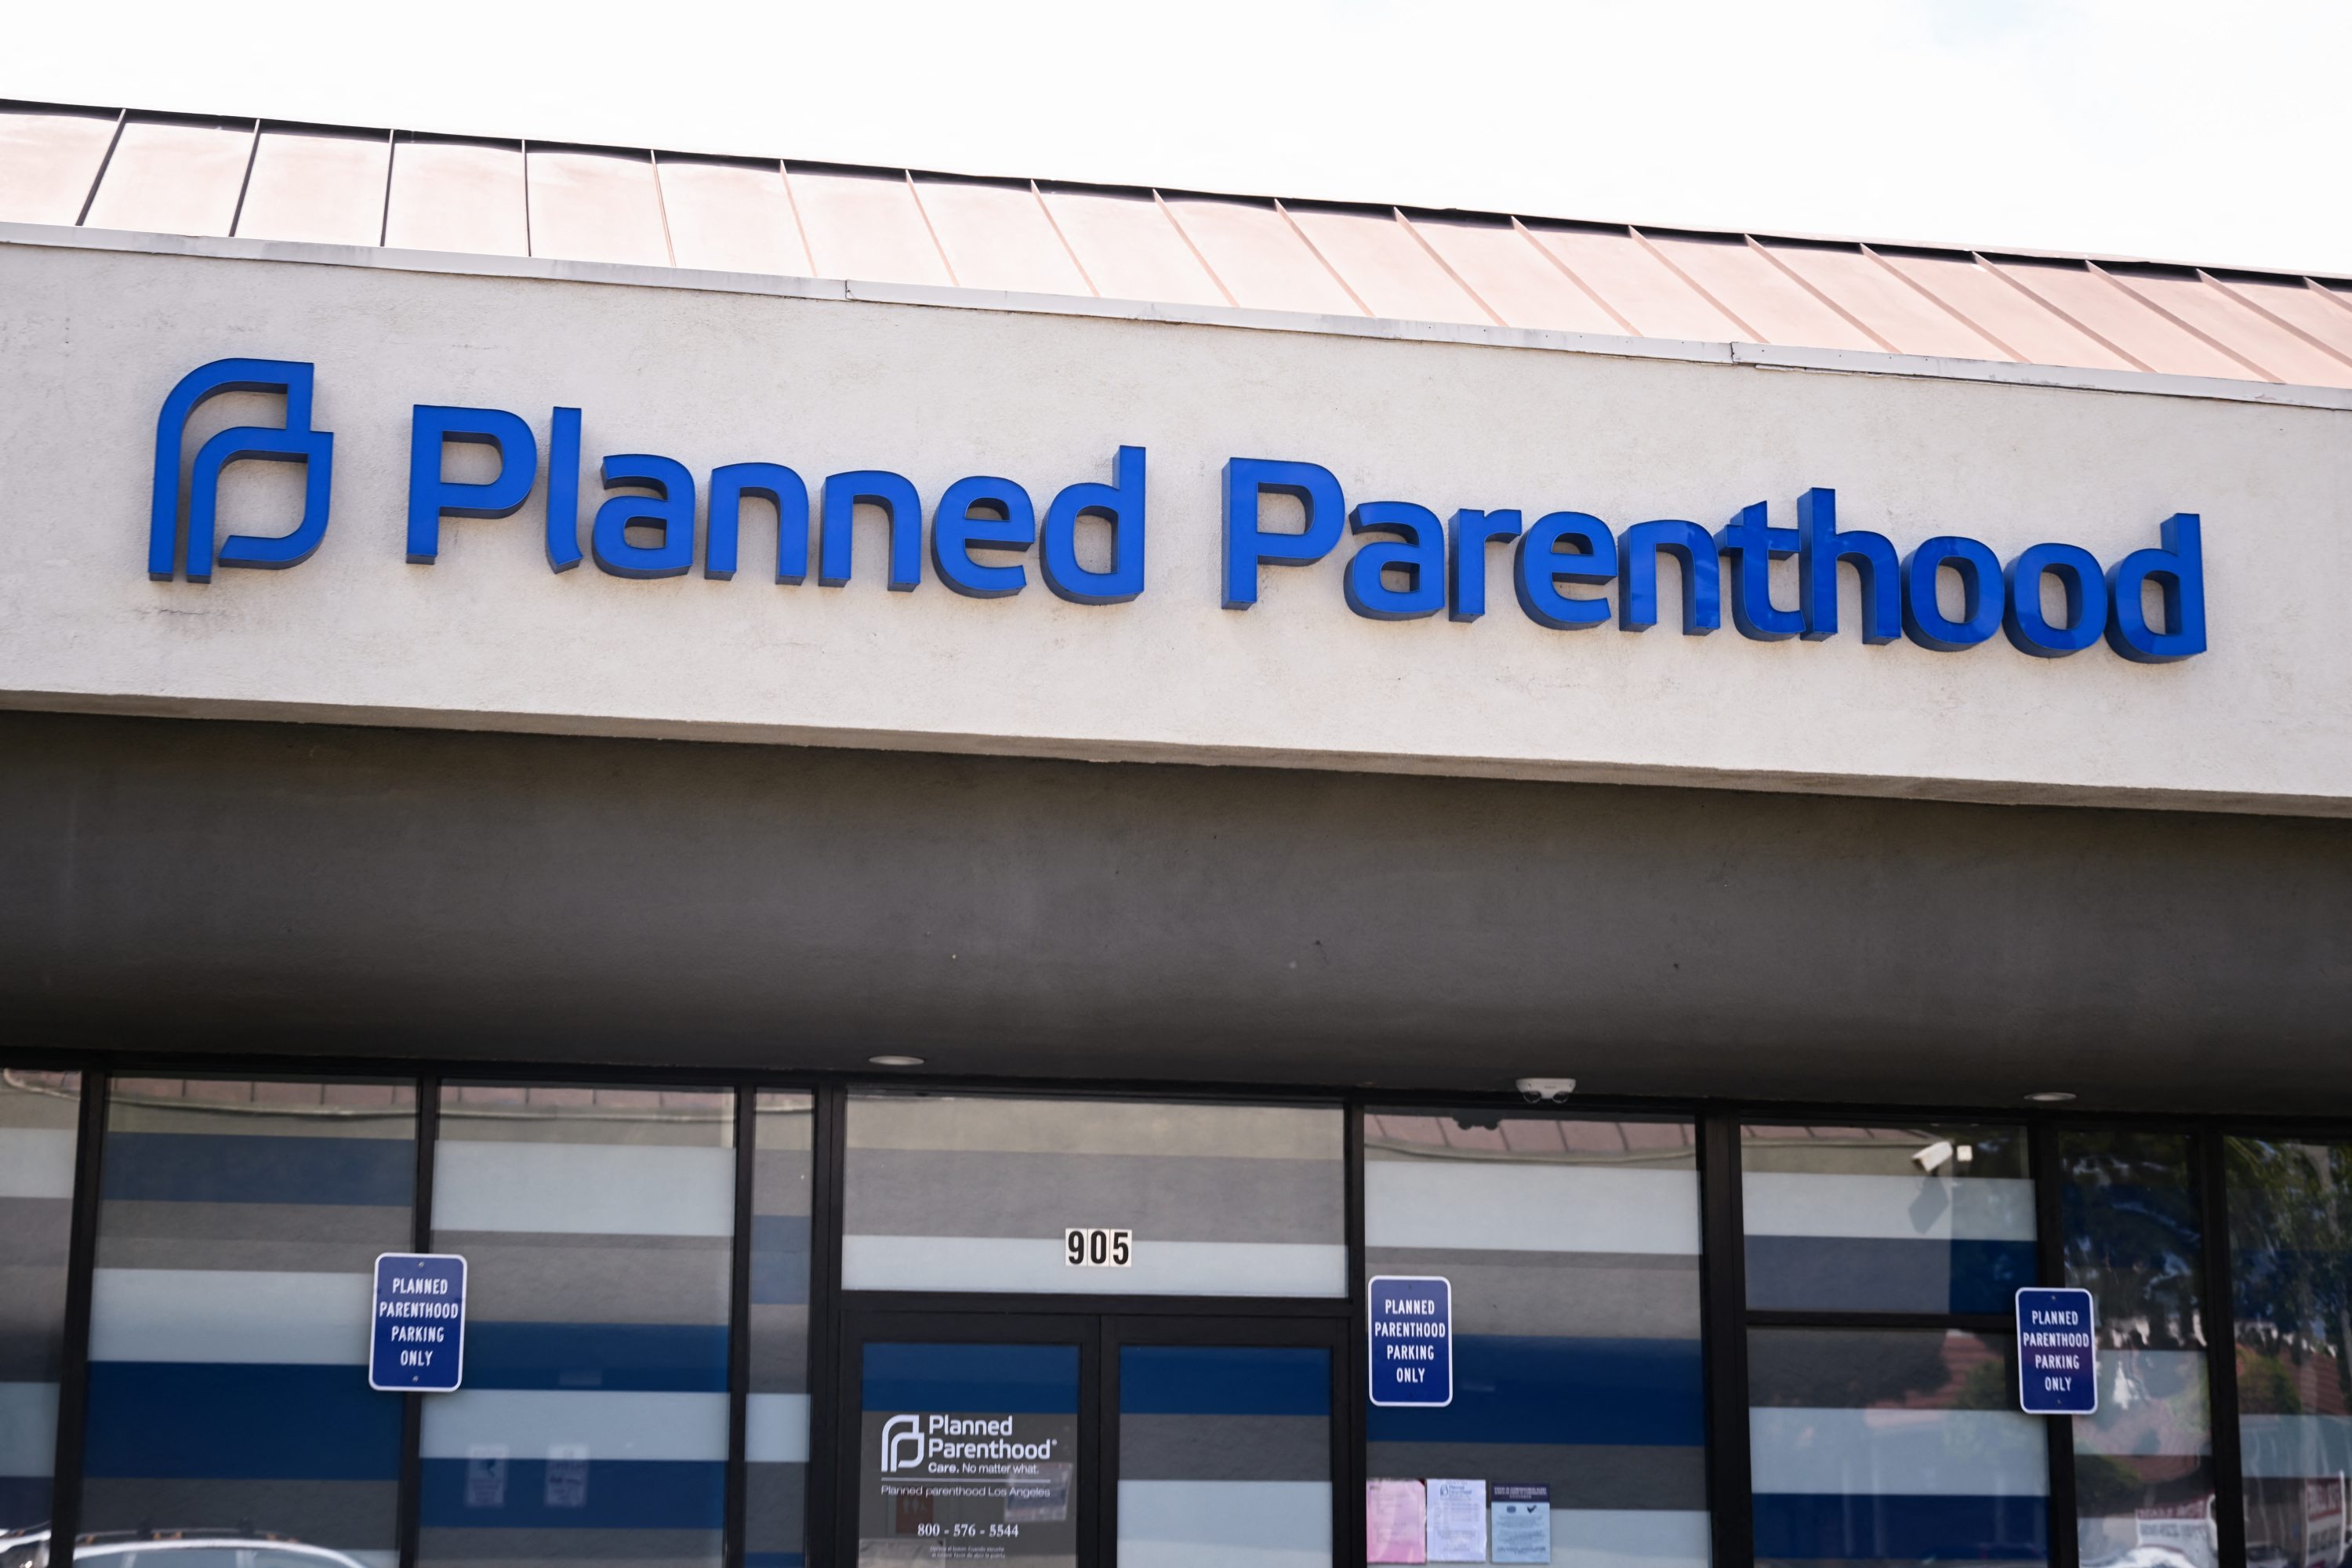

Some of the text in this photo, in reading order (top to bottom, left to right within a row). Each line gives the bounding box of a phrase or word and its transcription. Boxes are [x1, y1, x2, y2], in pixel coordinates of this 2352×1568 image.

[406, 404, 2207, 664] Planned Parenthood
[1068, 1230, 1129, 1265] 905
[392, 1278, 448, 1294] PLANNED
[379, 1301, 459, 1319] PARENTHOOD
[1385, 1299, 1435, 1315] PLANNED
[2031, 1310, 2078, 1326] PLANNED
[391, 1326, 445, 1343] PARKING
[1374, 1322, 1446, 1338] PARENTHOOD
[2023, 1332, 2089, 1348] PARENTHOOD
[400, 1350, 434, 1367] ONLY
[1387, 1345, 1435, 1360] PARKING
[2034, 1354, 2080, 1370] PARKING
[1396, 1367, 1425, 1383] ONLY
[2045, 1376, 2072, 1392] ONLY
[929, 1414, 1013, 1436] Planned
[928, 1462, 1040, 1474] Care. No matter what.
[880, 1484, 1050, 1499] Planned parenthood Los Angeles
[917, 1523, 940, 1537] 800
[953, 1523, 976, 1537] 576
[989, 1523, 1019, 1537] 5544
